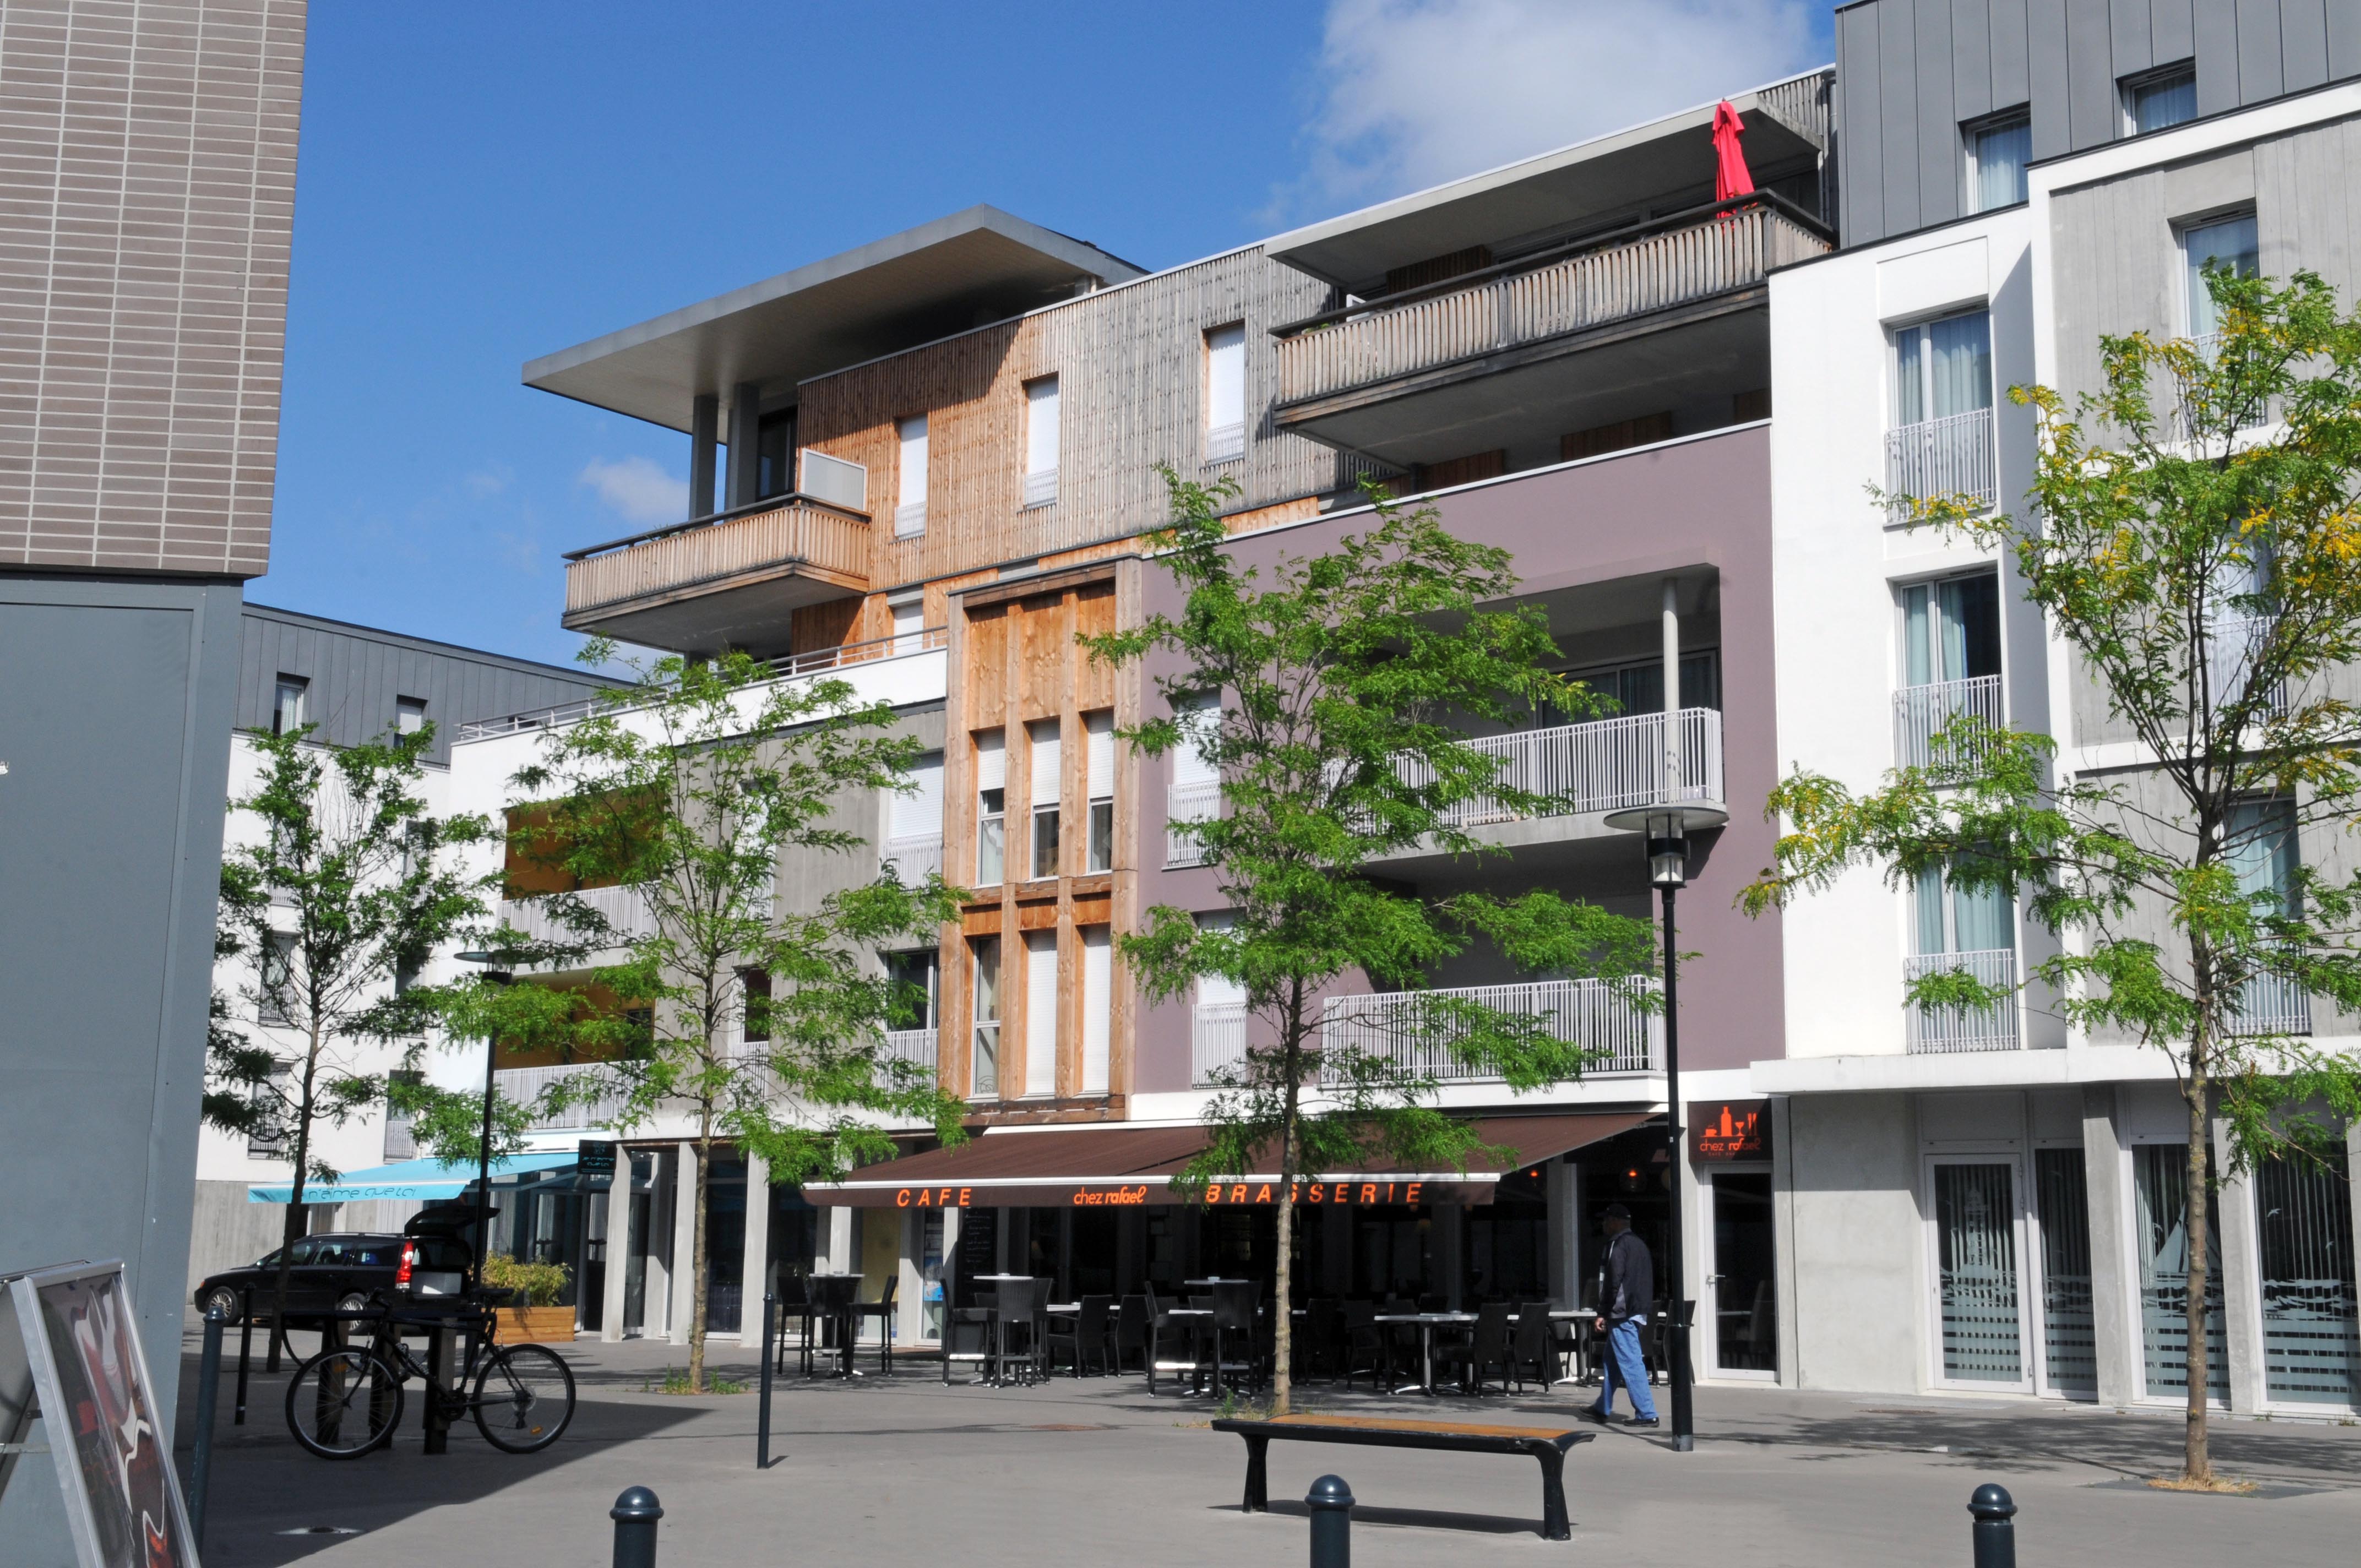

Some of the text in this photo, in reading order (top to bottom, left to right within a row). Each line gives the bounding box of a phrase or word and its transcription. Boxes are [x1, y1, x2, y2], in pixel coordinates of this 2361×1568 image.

[1700, 1138, 1724, 1152] chez
[365, 1187, 395, 1197] que
[897, 1189, 971, 1207] CAFE
[1074, 1185, 1147, 1205] chez rafael
